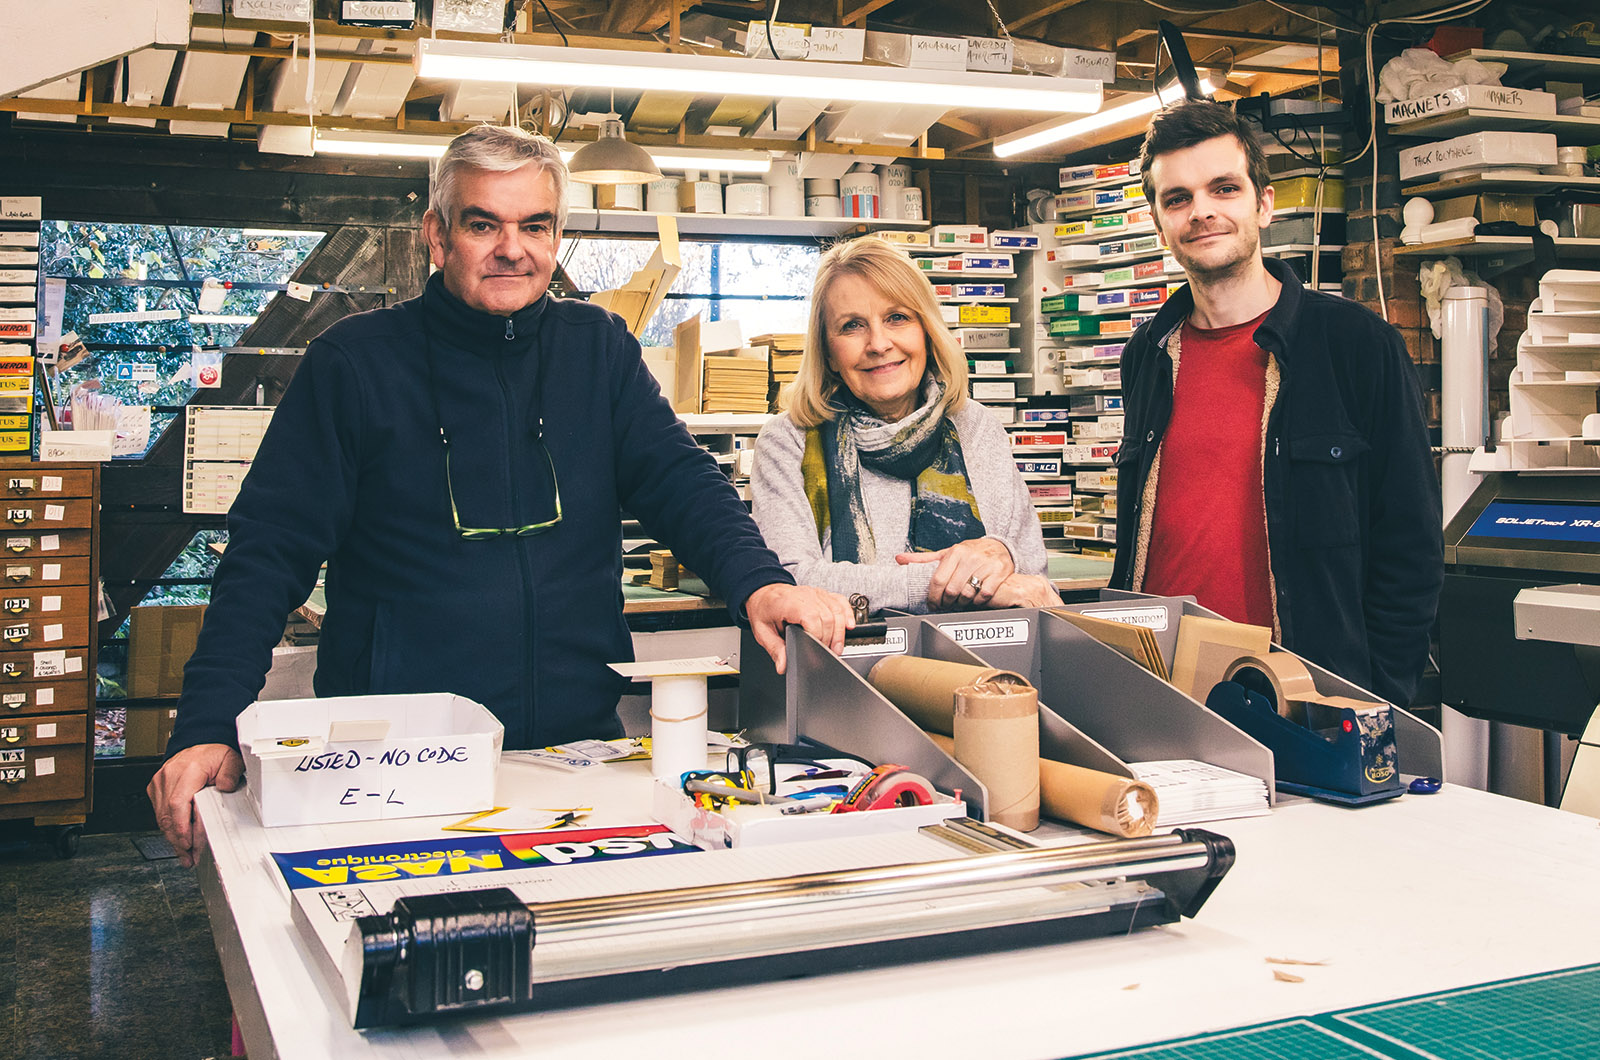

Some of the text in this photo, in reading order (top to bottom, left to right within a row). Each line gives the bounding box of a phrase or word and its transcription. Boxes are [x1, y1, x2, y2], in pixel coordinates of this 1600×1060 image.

[1392, 93, 1451, 119] MAGNETS
[1121, 614, 1164, 624] KINGDOM
[886, 636, 904, 645] RLD
[953, 626, 1015, 646] EUROPE
[295, 750, 361, 772] LISTED
[379, 748, 410, 766] NO
[417, 746, 468, 764] CODE
